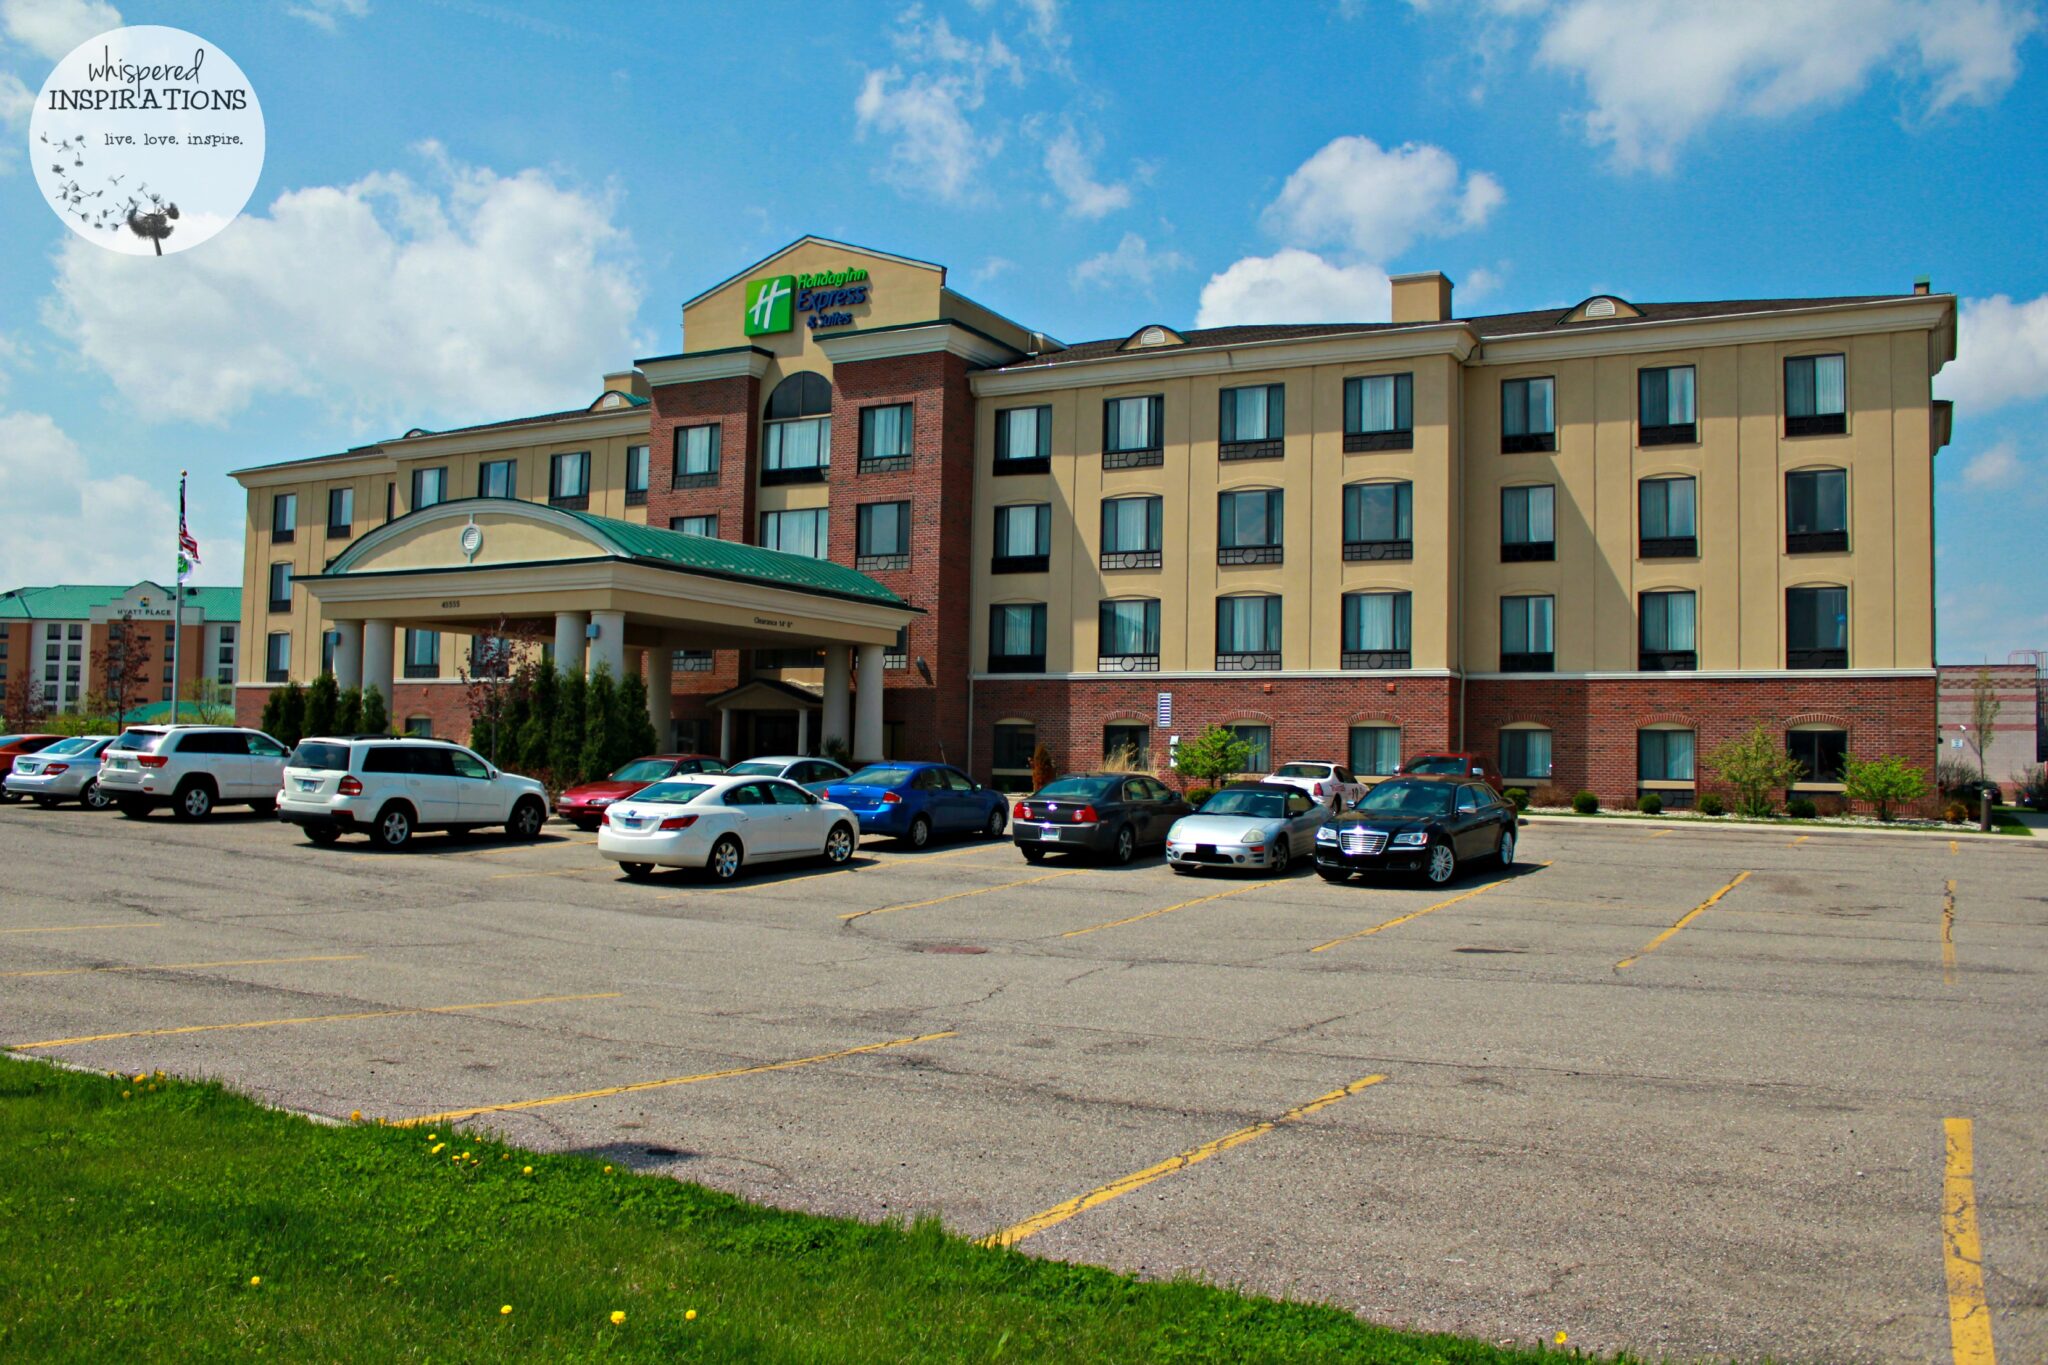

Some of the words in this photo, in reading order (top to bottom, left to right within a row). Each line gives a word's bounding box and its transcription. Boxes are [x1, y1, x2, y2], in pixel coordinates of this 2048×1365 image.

[798, 270, 846, 288] Holiday
[847, 266, 868, 281] Inn
[798, 285, 867, 314] Express
[807, 316, 817, 328] &
[819, 313, 852, 327] Suites
